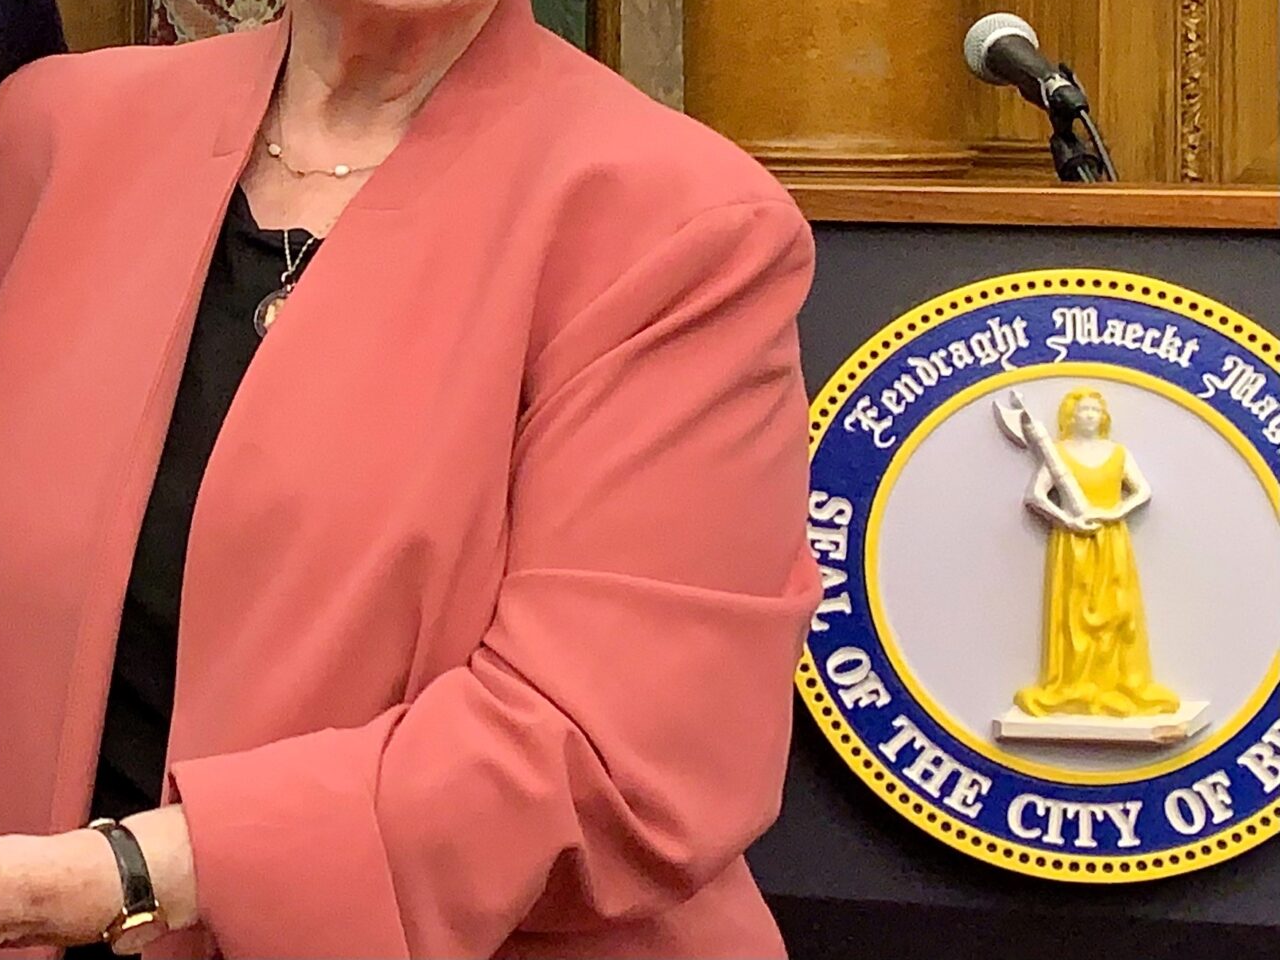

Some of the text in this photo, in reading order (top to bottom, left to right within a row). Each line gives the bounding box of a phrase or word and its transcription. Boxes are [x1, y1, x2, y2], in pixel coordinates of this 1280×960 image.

[844, 315, 1029, 449] Eendraght
[1046, 307, 1200, 368] Maeckt
[807, 490, 853, 632] SEAL
[826, 647, 891, 711] OF
[878, 714, 993, 818] THE
[1165, 771, 1237, 835] OF
[1007, 793, 1143, 847] CITY
